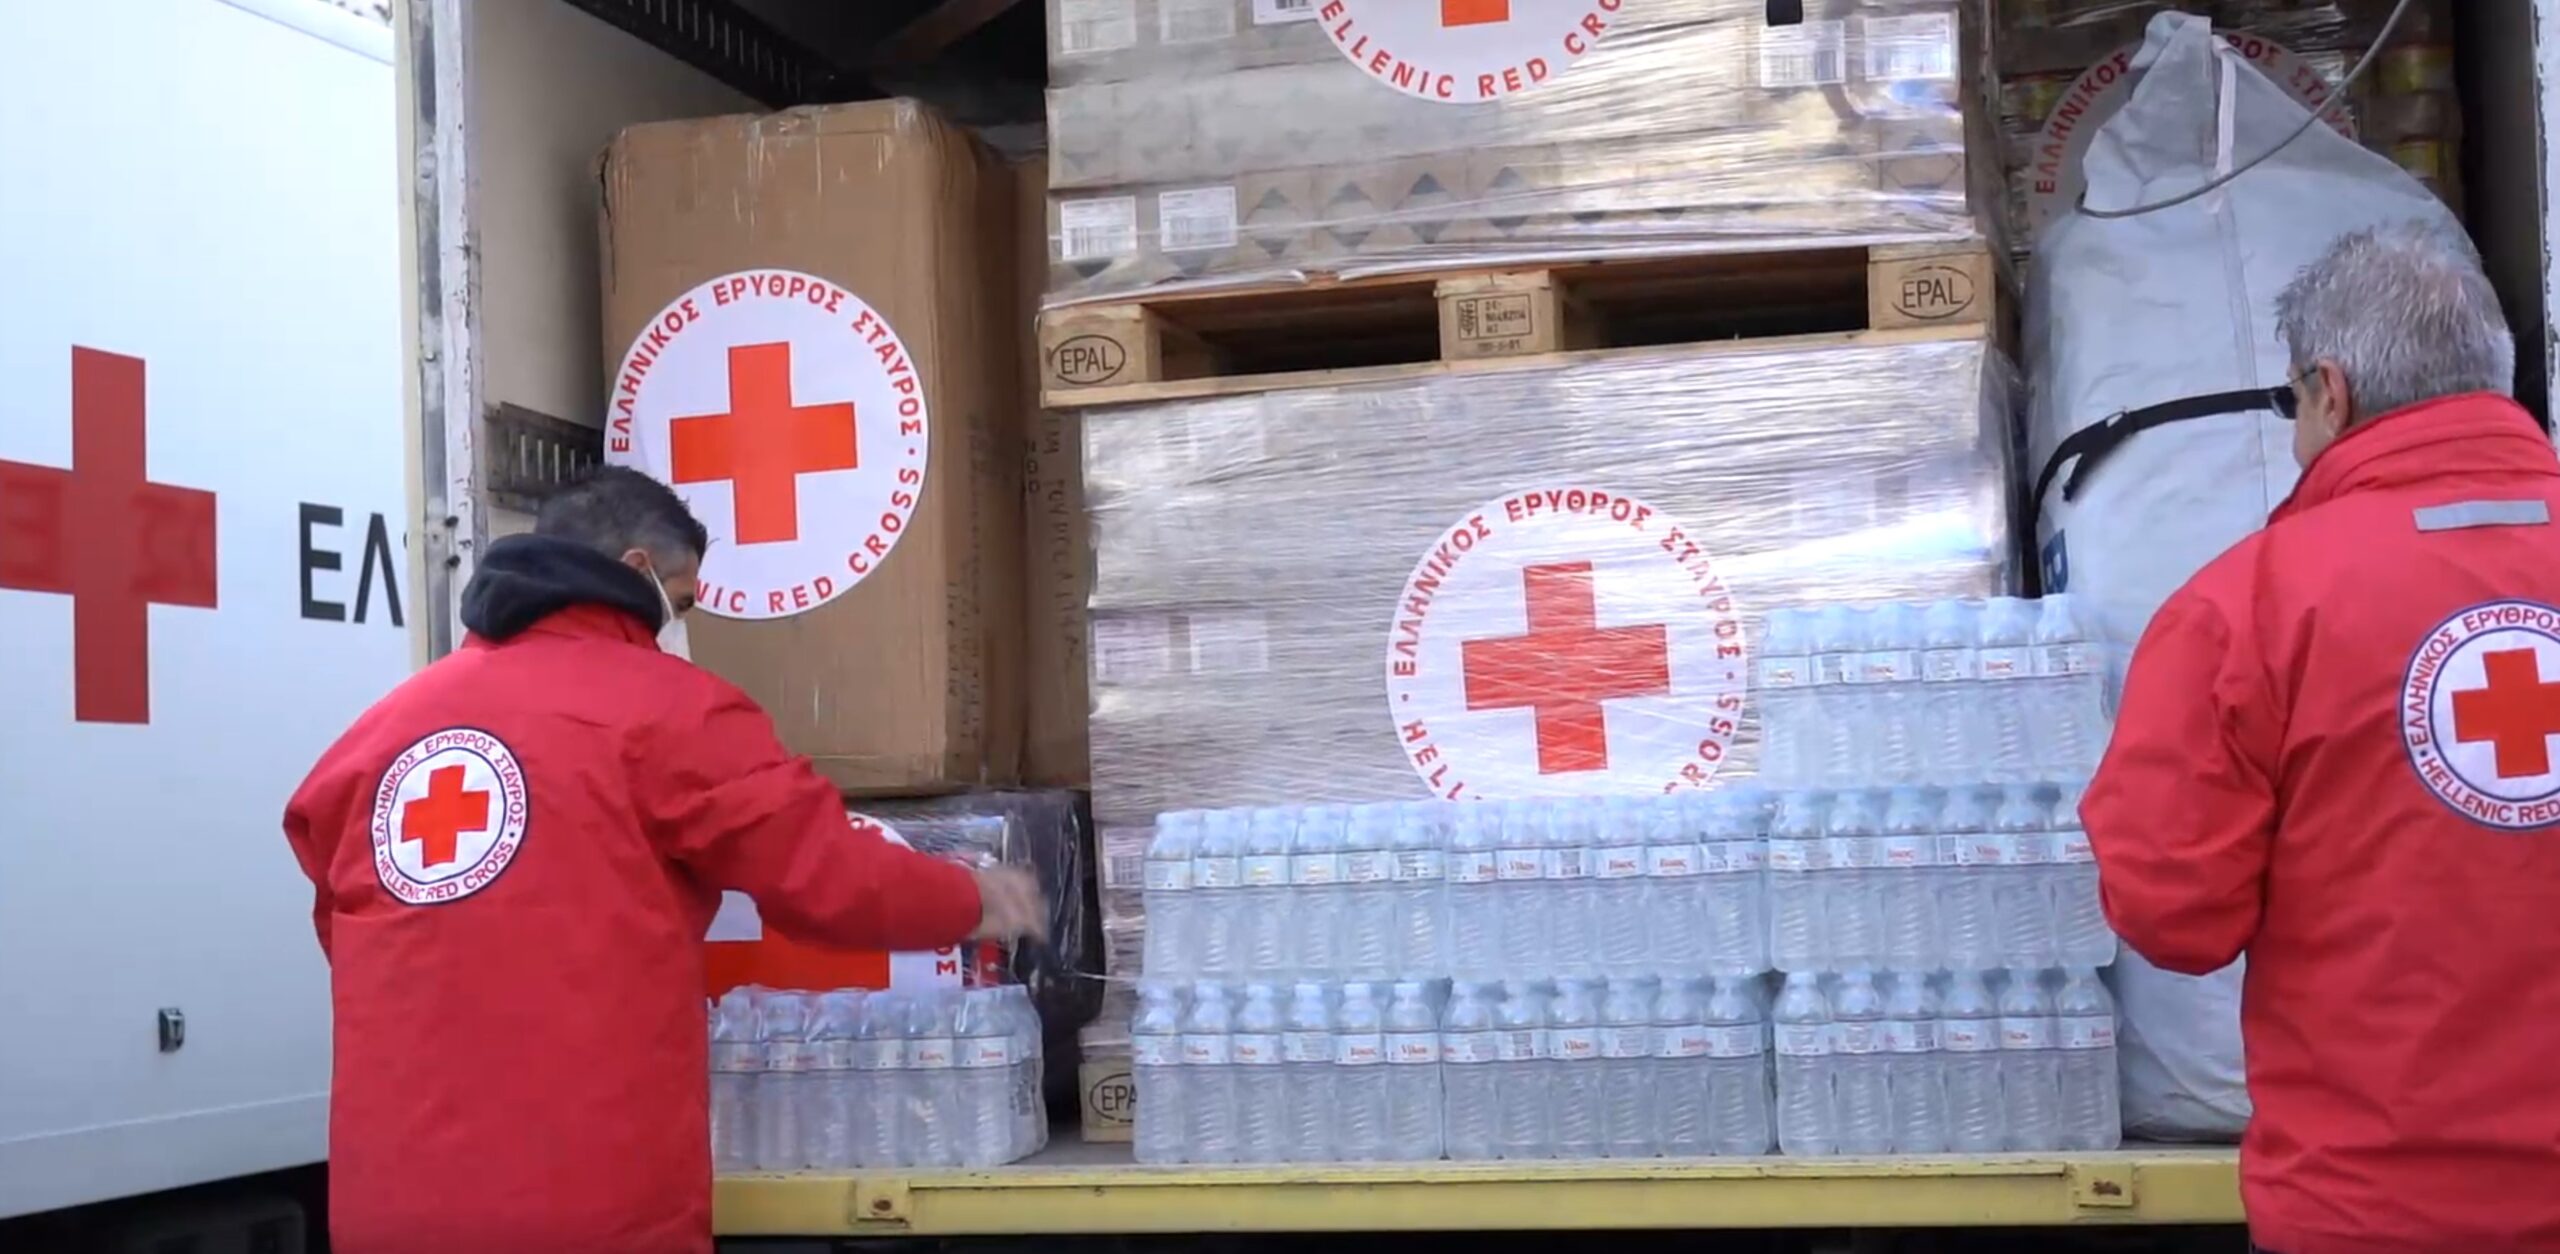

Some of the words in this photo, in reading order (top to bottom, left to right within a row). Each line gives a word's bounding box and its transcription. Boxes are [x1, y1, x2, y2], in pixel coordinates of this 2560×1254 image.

[1320, 0, 1455, 99] ELLENIC
[1477, 56, 1549, 99] RED
[1564, 0, 1623, 57] CRO
[2035, 51, 2130, 194] ΕΛΛΗΝΙΚΟΣ
[1902, 276, 1963, 309] EPAL
[611, 298, 701, 453] ΕΛΛΗΝΙΚΟΣ
[712, 273, 846, 315] ΕΡΥΘΡΟΣ
[850, 310, 922, 437] ΣΤΑΥΡΟΣ
[1061, 347, 1115, 377] EPAL
[768, 575, 834, 613] RED
[849, 466, 920, 575] CROSS
[1393, 514, 1493, 677] ΕΛΛΗΝΙΚΟΣ
[1503, 489, 1653, 532] ΕΡΥΘΡΟΣ
[2407, 628, 2460, 747] ΕΛΛΗΝΙΚΟΣ
[374, 750, 420, 847] ΕΛΛΗΝΙΚΟΣ
[424, 732, 498, 756] ΕΡΥΘΡΟΣ
[494, 753, 525, 828] ΣΤΑΥΡΟΣ
[1402, 719, 1466, 802] HELL
[2420, 756, 2514, 824] HELLENIC
[2517, 799, 2560, 824] RED
[426, 881, 459, 900] RED
[463, 840, 514, 891] CROSS
[1101, 1083, 1138, 1112] EPA
